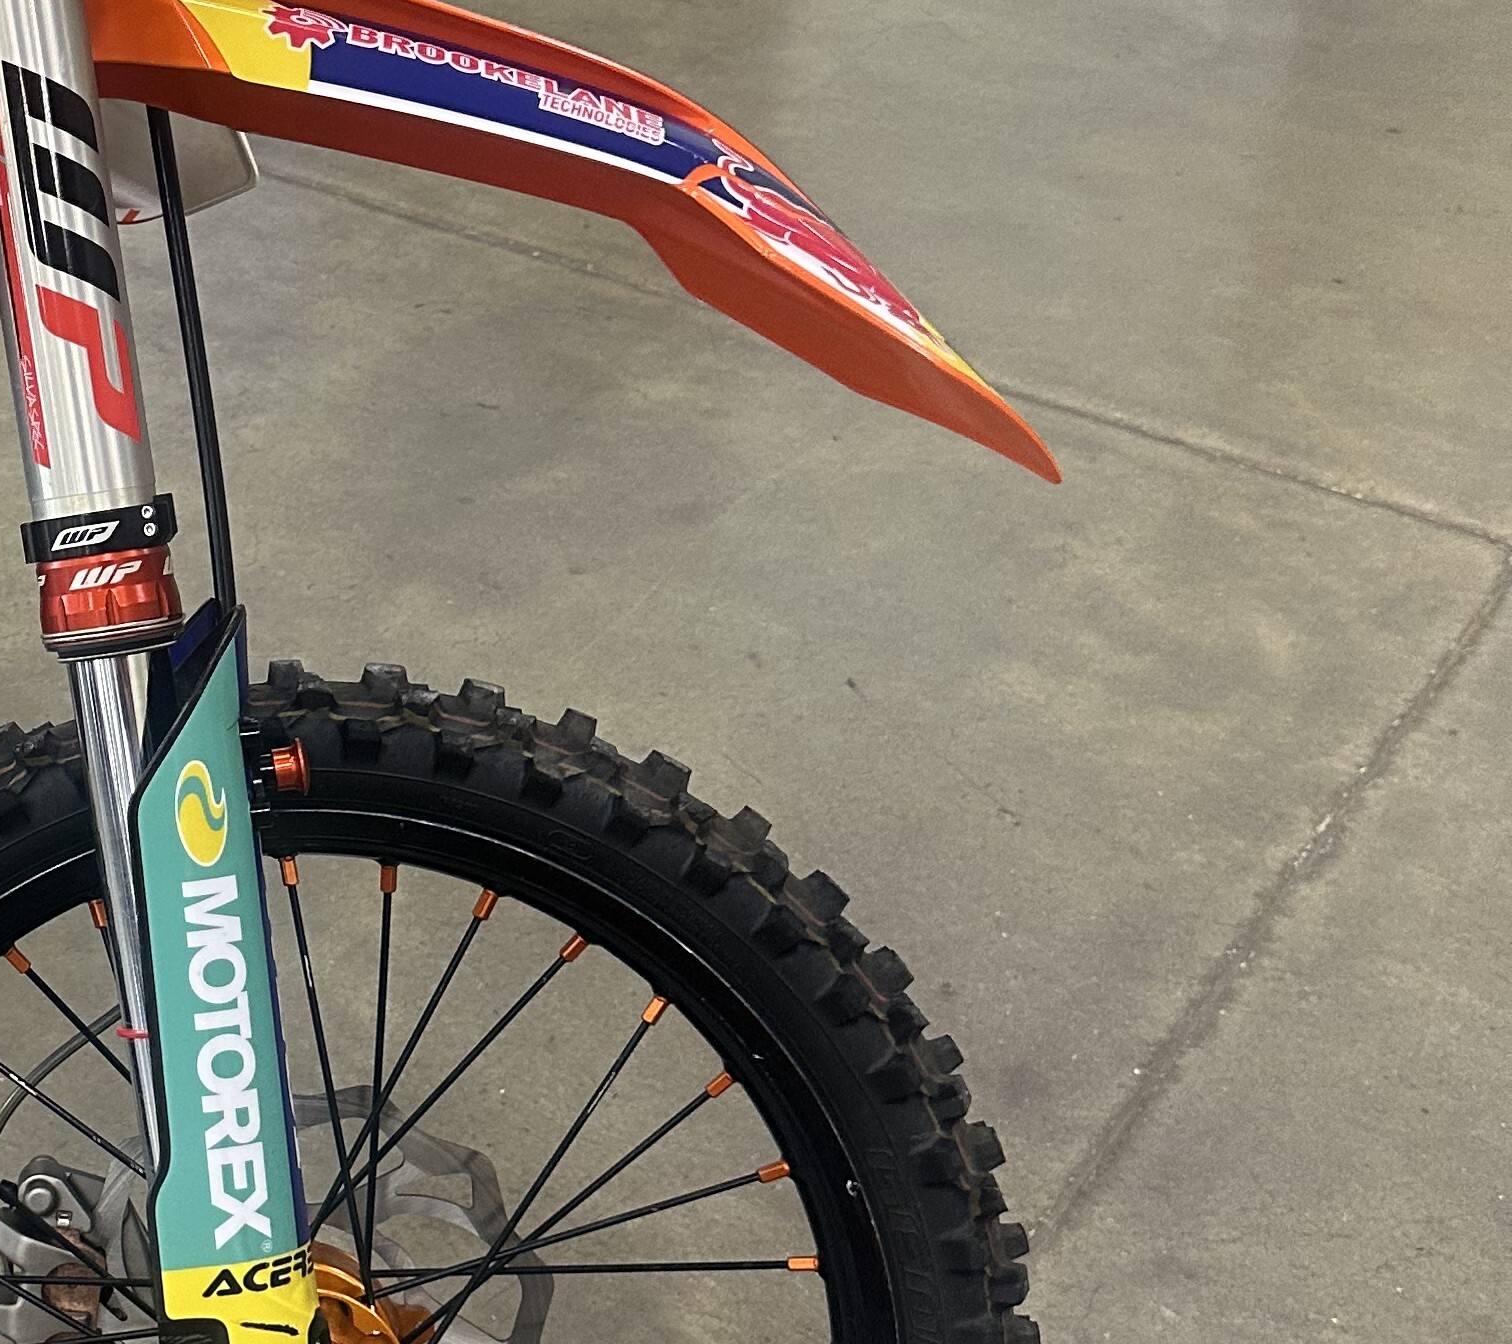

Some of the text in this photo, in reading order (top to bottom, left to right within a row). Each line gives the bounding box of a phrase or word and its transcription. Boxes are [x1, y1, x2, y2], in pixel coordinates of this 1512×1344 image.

[349, 24, 664, 131] BROOKELANE
[542, 94, 661, 142] TECHNOLOGIES
[1, 59, 141, 444] WP
[55, 523, 114, 548] WP
[69, 560, 142, 590] WP
[182, 873, 273, 1251] MOTOREX
